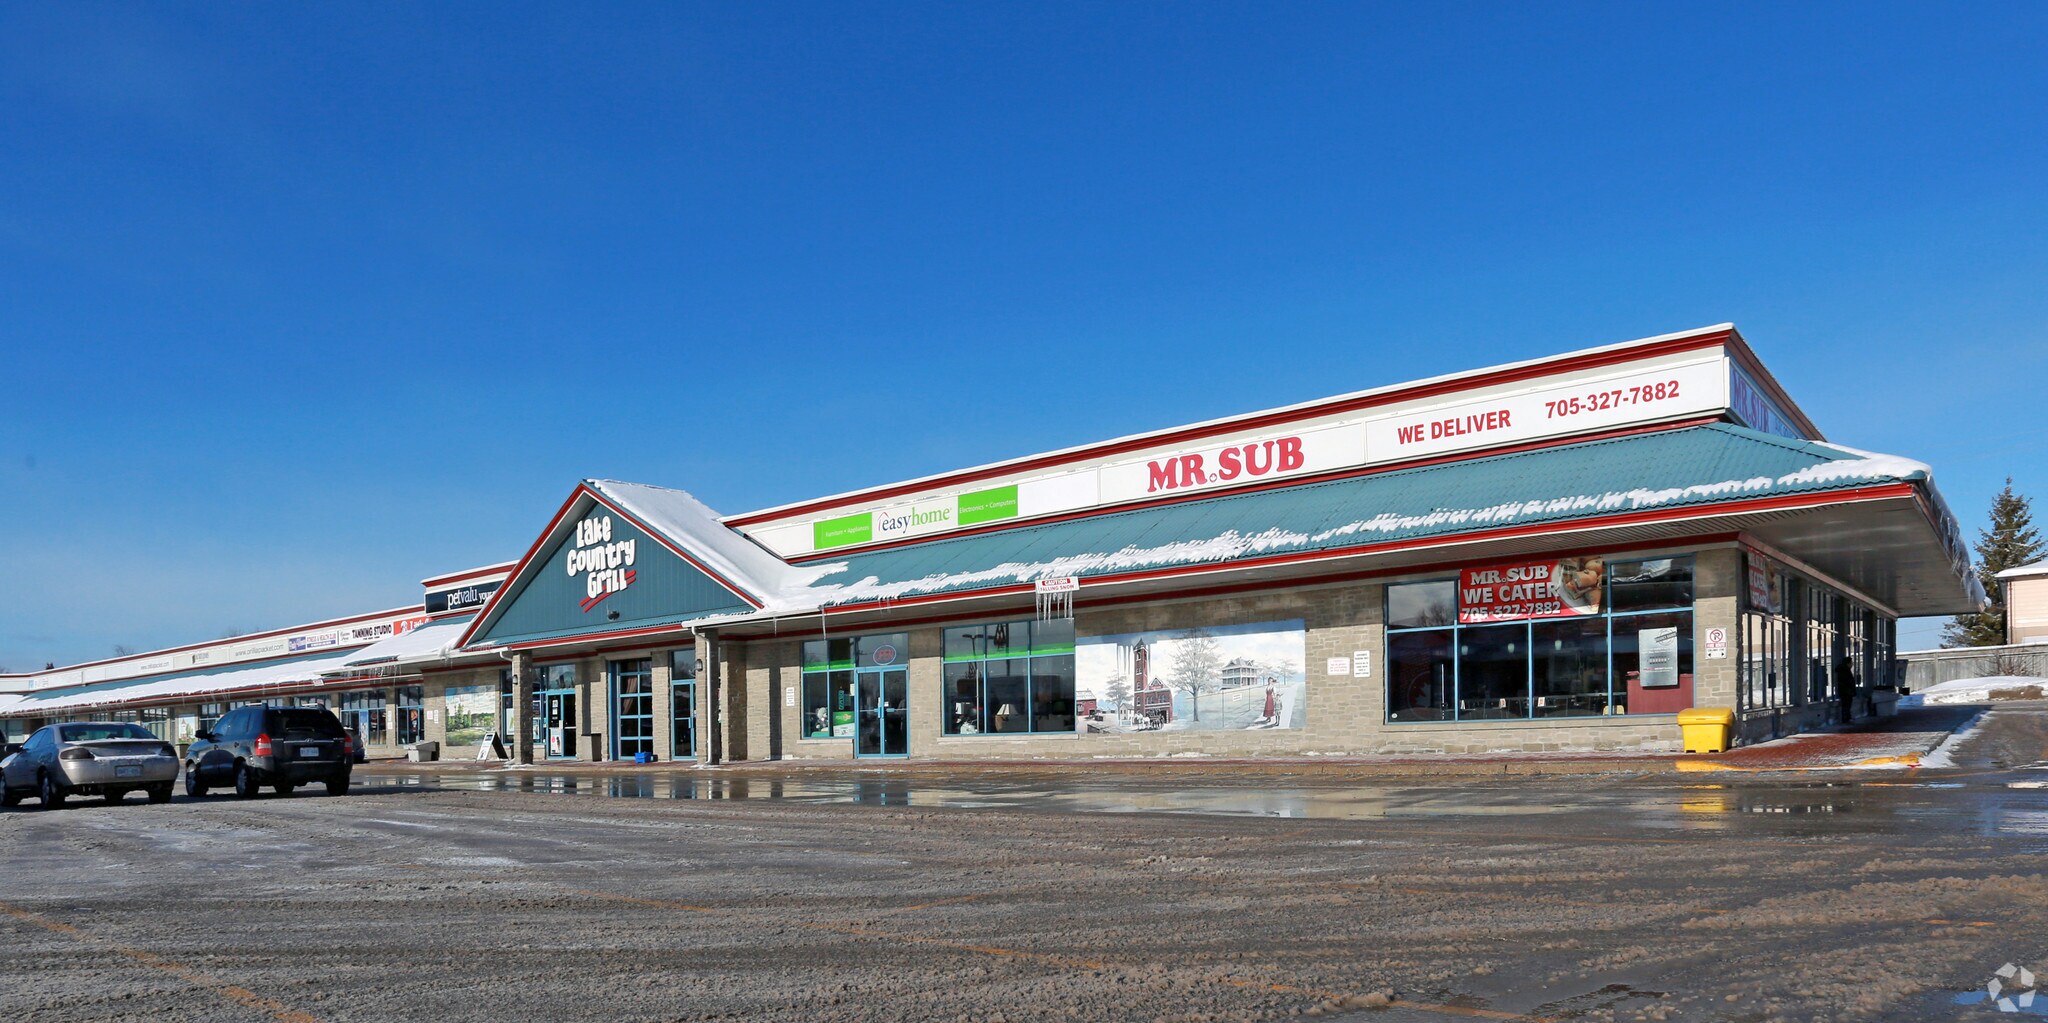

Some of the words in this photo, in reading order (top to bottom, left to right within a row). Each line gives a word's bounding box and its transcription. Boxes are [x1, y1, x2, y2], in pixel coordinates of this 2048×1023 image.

[1397, 423, 1425, 445] WE
[1431, 409, 1512, 440] DELIVER
[1545, 380, 1680, 419] 705-327-7882
[990, 499, 1016, 508] Computers
[881, 507, 950, 533] easyhome
[576, 515, 612, 549] Lake
[566, 538, 636, 577] Country
[1045, 578, 1067, 586] CAUTION
[1463, 587, 1494, 605] WE
[1499, 582, 1560, 603] CATER
[447, 587, 478, 610] petvalu
[1461, 601, 1561, 620] 705-327-7882
[352, 627, 373, 639] TANNING
[374, 624, 392, 635] STUDIO
